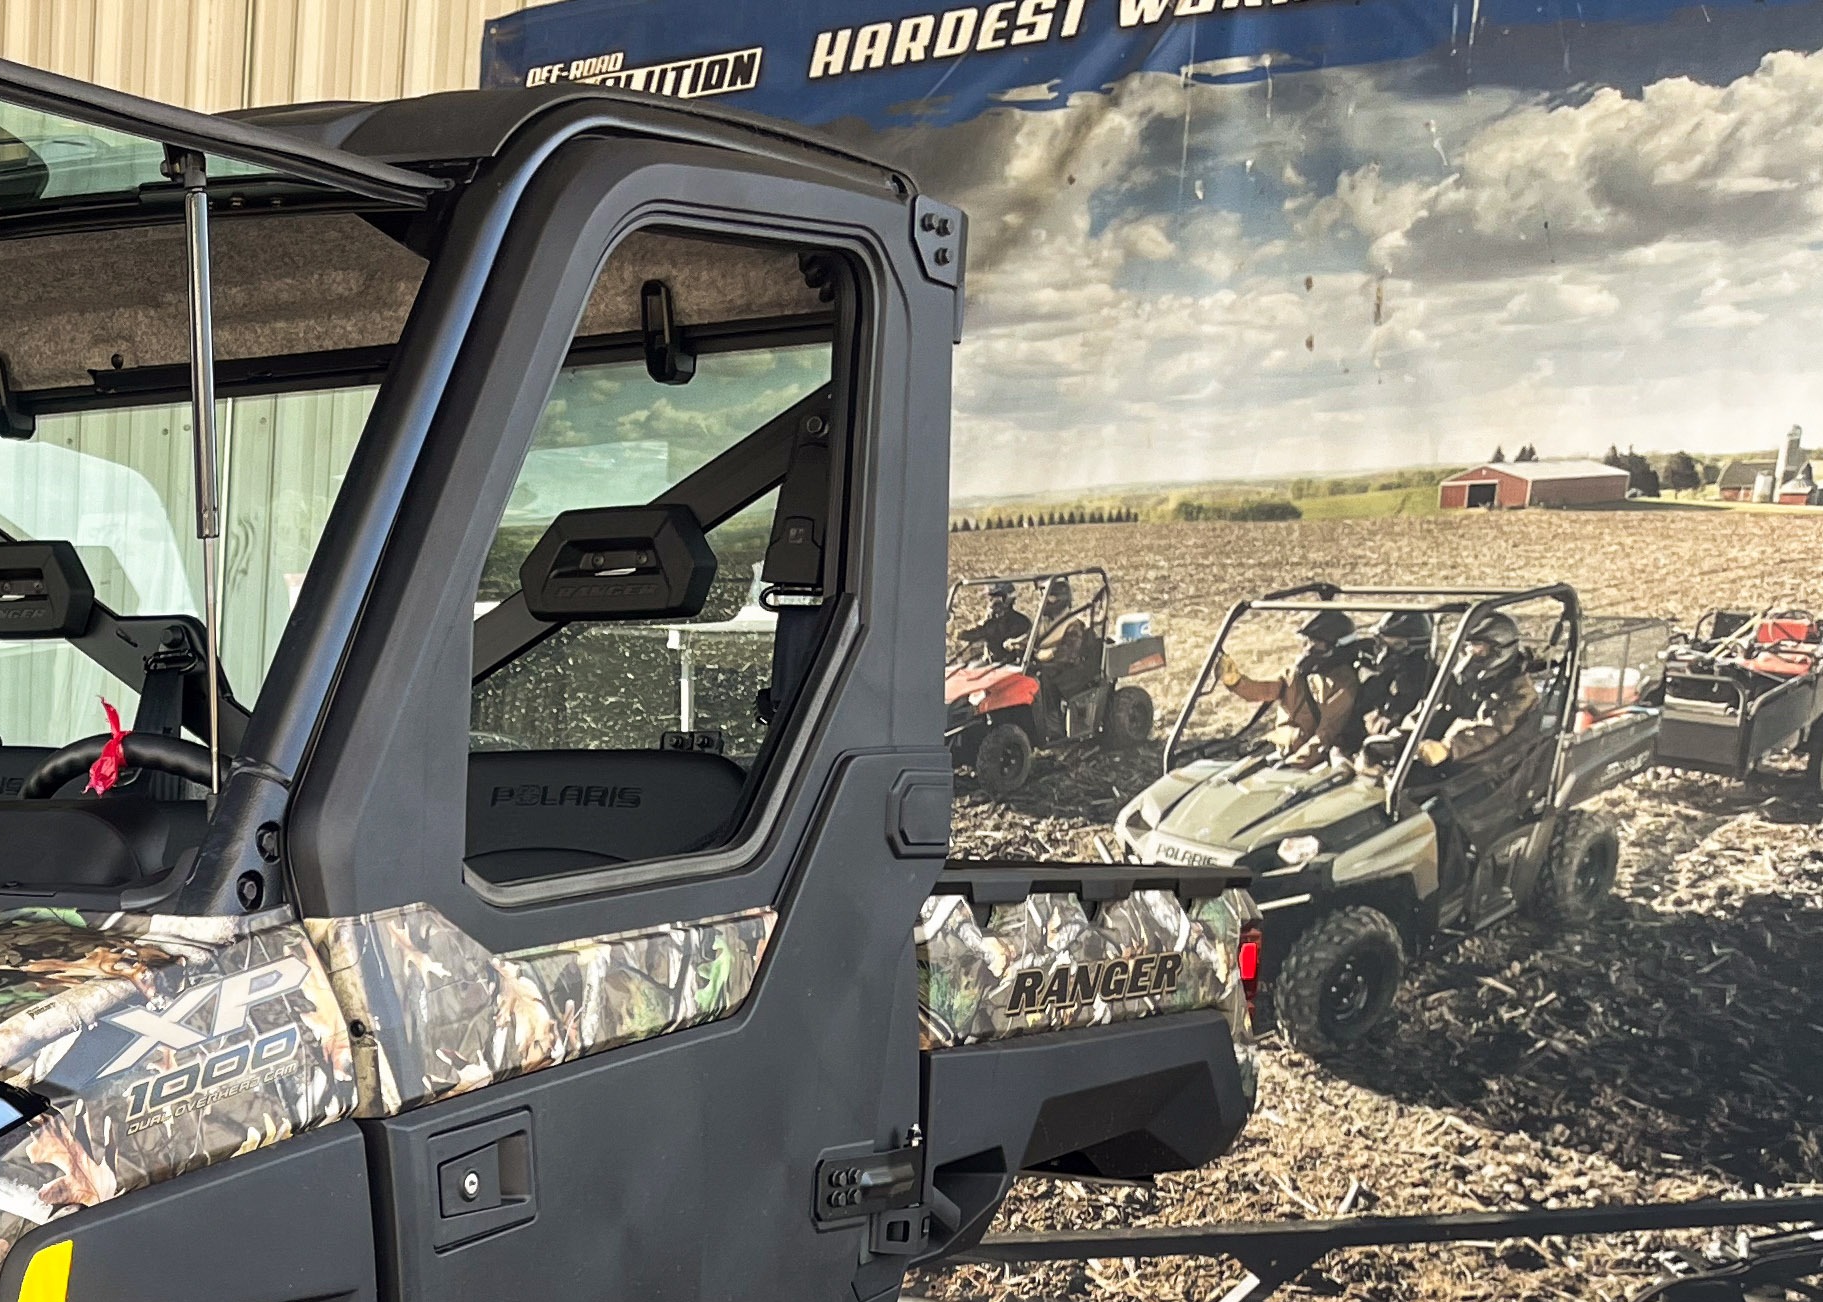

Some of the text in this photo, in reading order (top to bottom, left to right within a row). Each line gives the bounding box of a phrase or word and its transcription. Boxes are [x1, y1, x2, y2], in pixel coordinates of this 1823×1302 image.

[490, 784, 643, 809] POLARIS
[96, 954, 311, 1079] XP
[1005, 951, 1182, 1016] RANGER
[124, 1023, 300, 1121] 1000
[127, 1062, 297, 1135] DUAL OVERHEAD CAM
